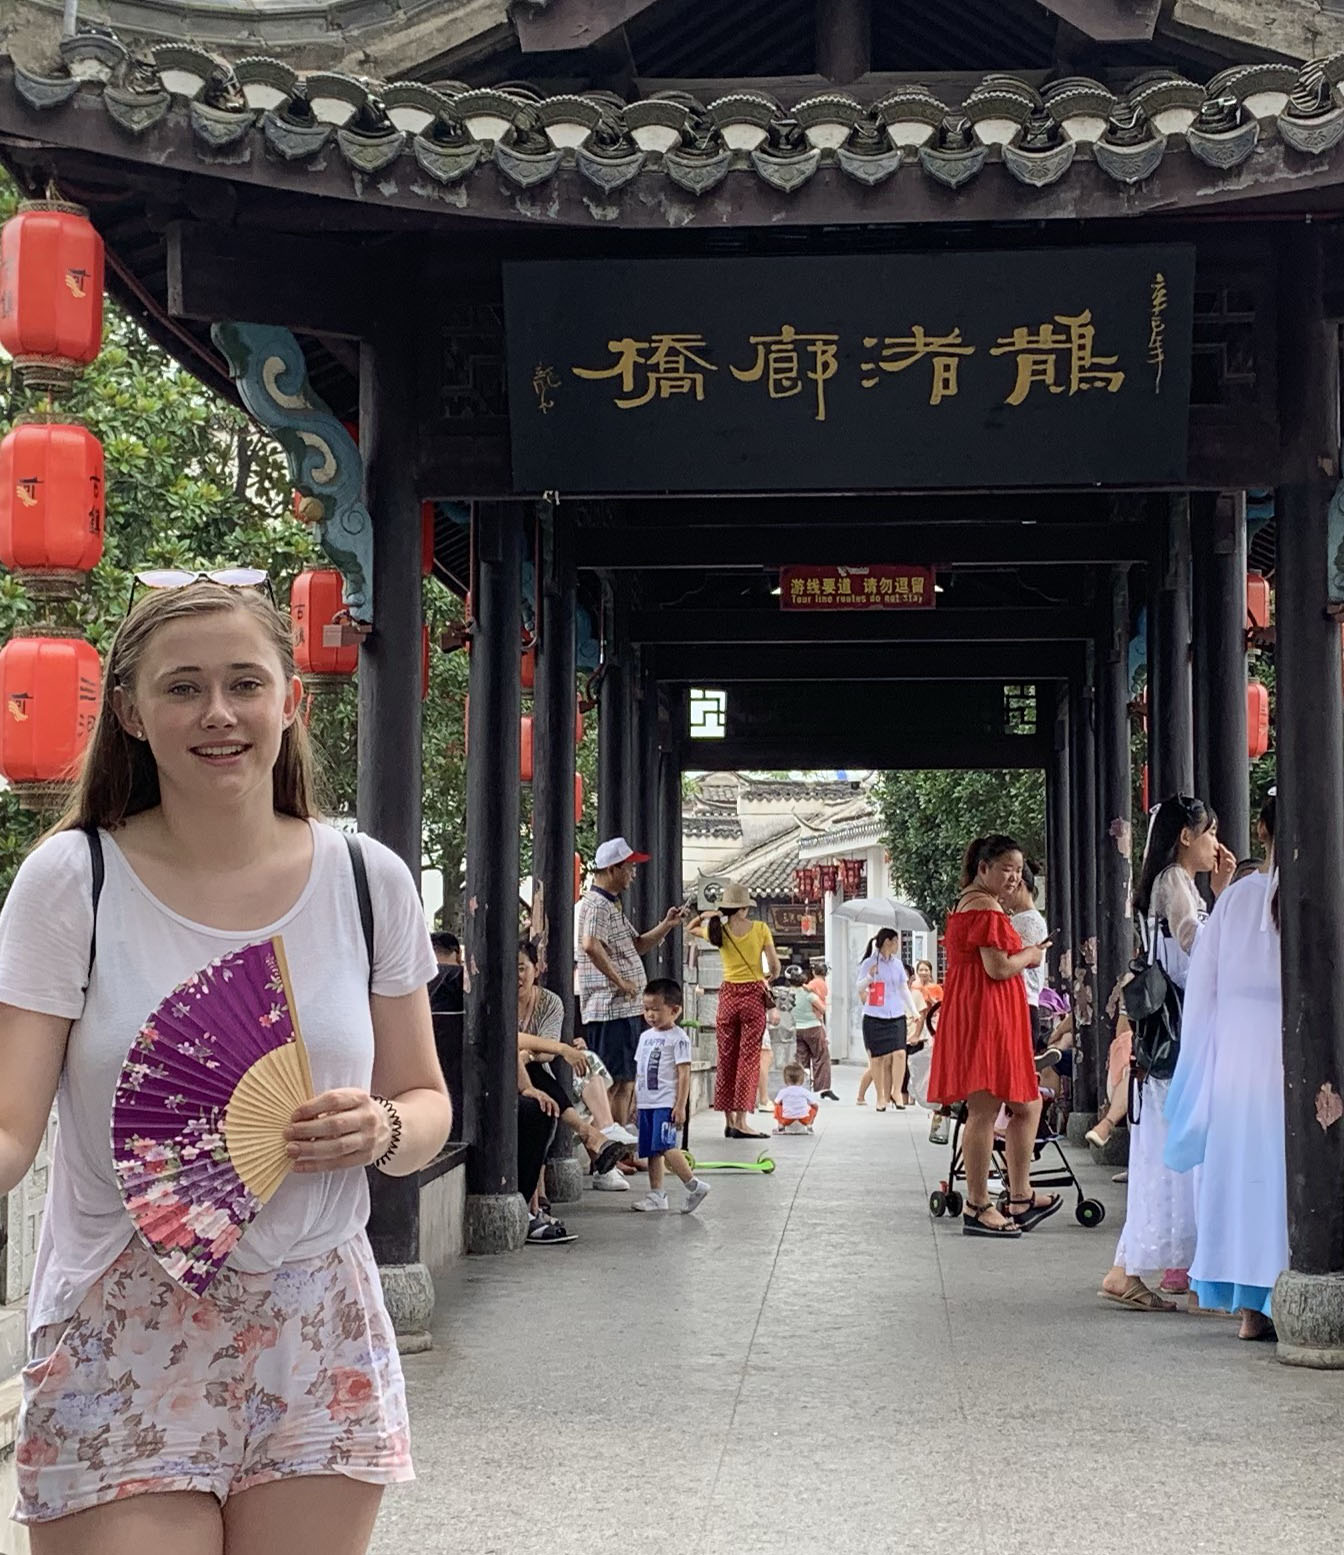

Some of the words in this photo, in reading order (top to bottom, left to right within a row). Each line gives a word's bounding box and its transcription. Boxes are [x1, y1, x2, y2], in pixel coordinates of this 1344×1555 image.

[790, 577, 852, 595] 游线要道
[863, 576, 925, 594] 请勿逗留
